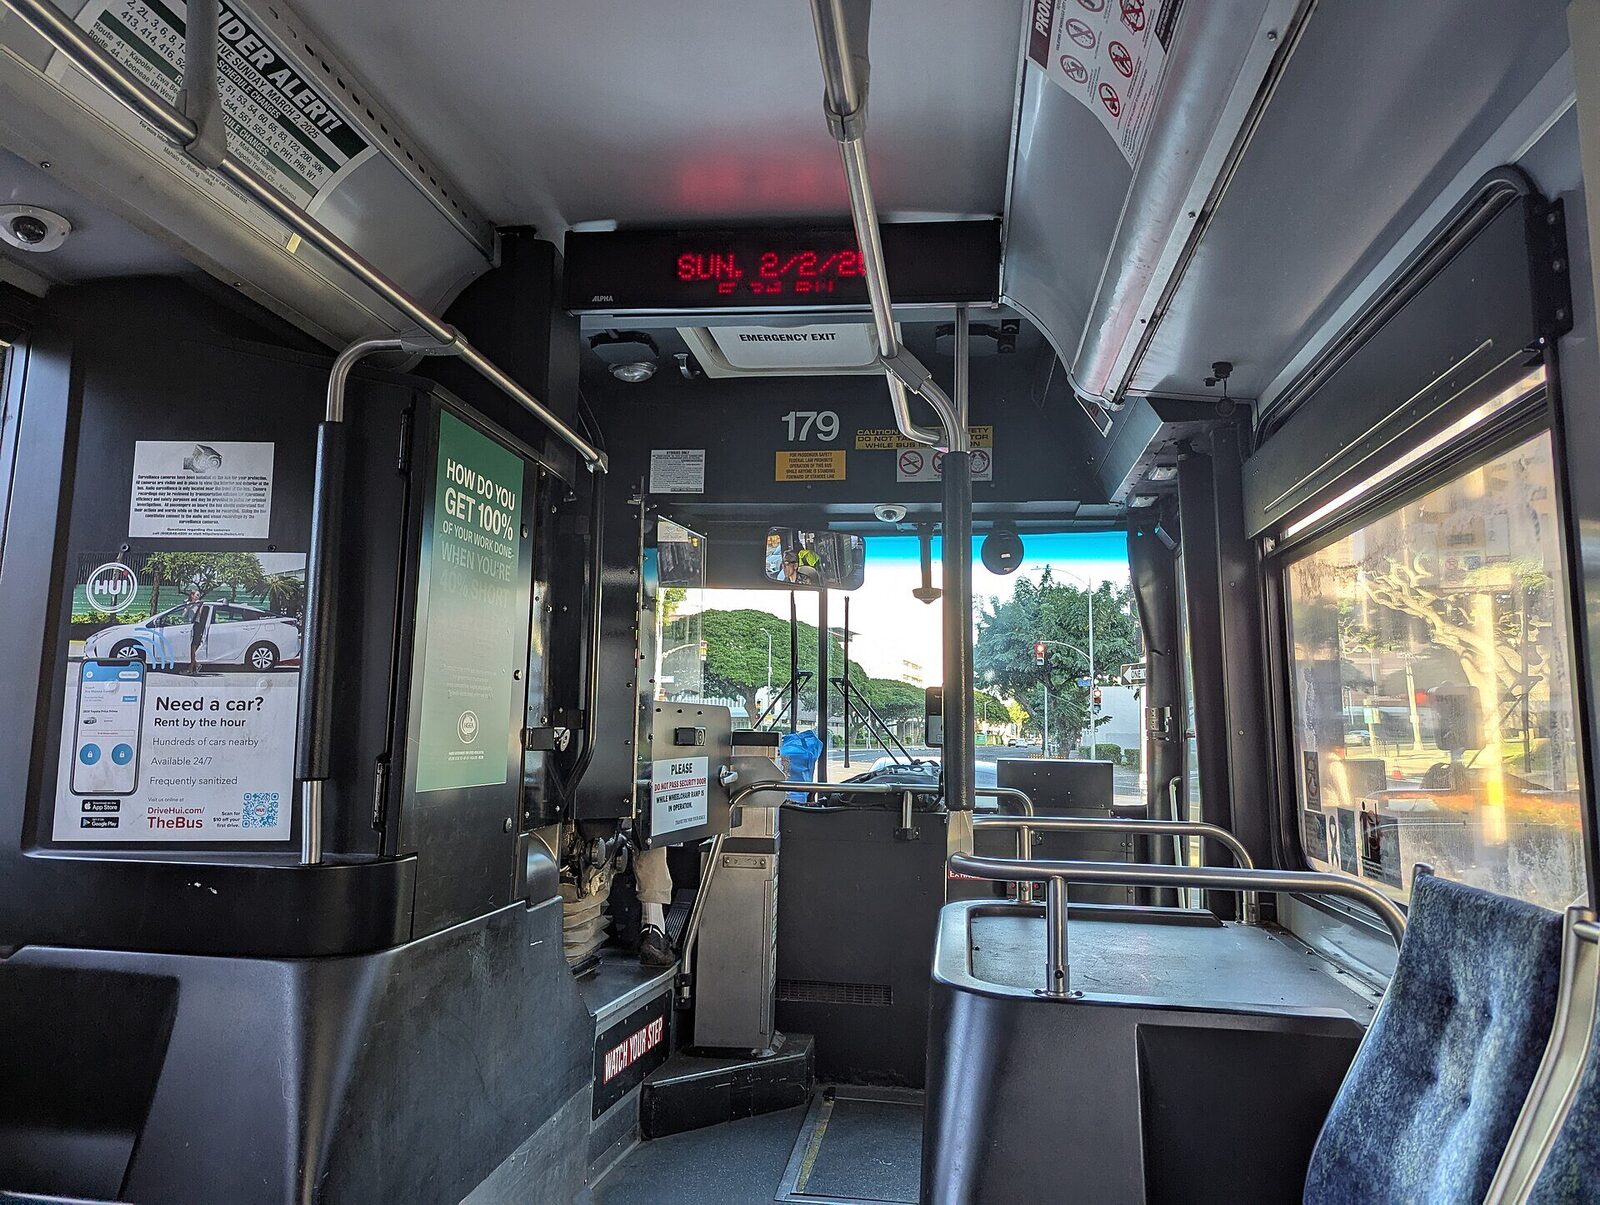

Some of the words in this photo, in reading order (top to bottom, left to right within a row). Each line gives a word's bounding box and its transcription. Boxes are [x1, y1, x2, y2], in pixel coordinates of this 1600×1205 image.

[121, 11, 139, 30] 413,
[140, 28, 157, 46] 414,
[159, 44, 175, 61] 416,
[136, 6, 148, 22] 2L,
[151, 19, 159, 30] 3,
[160, 27, 169, 38] 6,
[169, 35, 177, 46] 8,
[88, 30, 108, 48] Route
[111, 48, 120, 57] 44
[150, 79, 160, 91] UH
[160, 88, 174, 102] West
[93, 22, 114, 40] Route
[116, 41, 125, 49] 41
[129, 51, 153, 72] Kapolei
[156, 73, 169, 87] Ewa
[218, 0, 275, 70] IDER
[267, 68, 342, 134] ALERT!
[217, 60, 253, 95] SCHEDULE
[250, 91, 281, 119] CHANGES
[232, 58, 267, 92] SUNDAY,
[266, 89, 295, 116] MARCH
[293, 115, 301, 125] 2,
[301, 122, 319, 138] 2025
[223, 99, 238, 115] 544,
[238, 111, 252, 127] 551,
[252, 124, 266, 139] 552,
[266, 136, 274, 145] A,
[273, 142, 280, 151] C,
[280, 148, 293, 164] PH1,
[293, 159, 306, 175] PH6,
[306, 170, 317, 180] W1
[225, 85, 236, 98] 51,
[237, 95, 247, 107] 53,
[247, 104, 258, 116] 54,
[258, 113, 268, 126] 60,
[268, 122, 278, 134] 65,
[278, 133, 288, 144] 83,
[287, 140, 301, 155] 123,
[300, 151, 312, 166] 200,
[312, 161, 324, 175] 306,
[240, 127, 269, 156] CHANGES
[678, 252, 742, 280] SUN.
[739, 333, 807, 342] EMERGENCY
[782, 411, 839, 441] 179
[446, 458, 475, 490] HOW
[477, 474, 493, 499] DO
[495, 484, 515, 511] YOU
[444, 487, 476, 523] GET
[478, 502, 513, 541] 100%
[443, 520, 454, 534] OF
[454, 525, 472, 544] YOUR
[474, 532, 494, 549] WORK
[495, 539, 512, 558] DONE
[441, 542, 473, 570] WHEN
[477, 552, 511, 582] YOU'RE
[95, 580, 127, 595] HUI
[156, 696, 204, 711] Need
[210, 700, 219, 711] a
[226, 696, 264, 711] car?
[154, 718, 180, 727] Rent
[183, 718, 196, 729] by
[199, 718, 217, 727] the
[220, 718, 246, 727] hour
[152, 737, 195, 746] Hundreds
[197, 737, 207, 746] of
[228, 737, 259, 748] nearby
[150, 757, 191, 765] Available
[193, 757, 212, 765] 24/7
[671, 763, 692, 775] PLEASE
[150, 777, 196, 787] Frequently
[198, 776, 238, 784] sanitized
[654, 783, 660, 791] DO
[669, 781, 678, 789] PASS
[680, 779, 696, 787] SECURITY
[697, 777, 706, 786] DOOR
[669, 792, 690, 802] WHEELCHAIR
[673, 802, 692, 811] OPERATION.
[147, 817, 203, 828] TheBus
[606, 1040, 628, 1082] WATCH
[630, 1028, 646, 1063] YOUR
[648, 1017, 662, 1049] STEP
